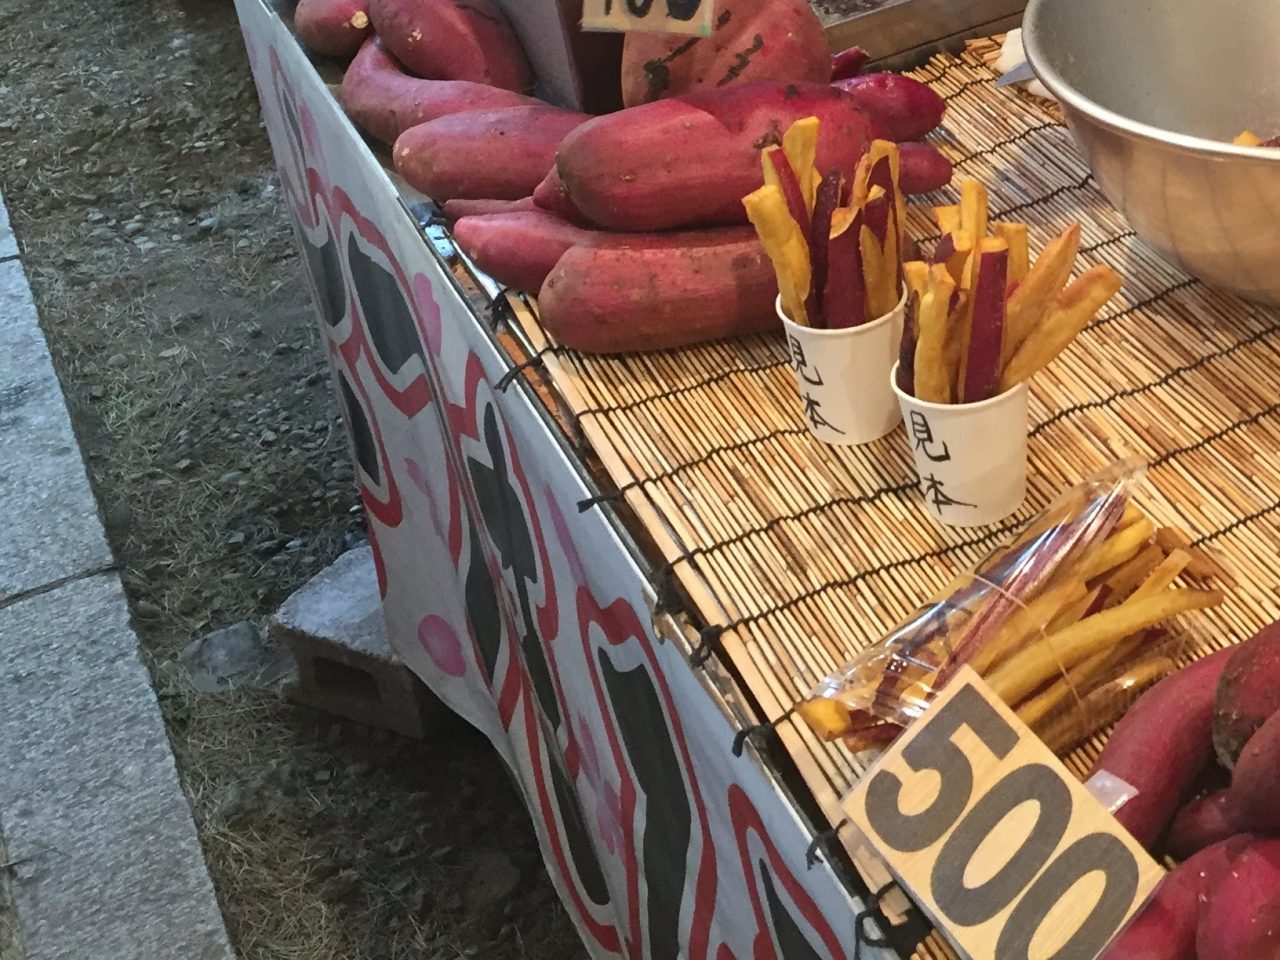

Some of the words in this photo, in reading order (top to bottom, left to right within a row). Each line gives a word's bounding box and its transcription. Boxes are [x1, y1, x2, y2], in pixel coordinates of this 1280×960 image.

[789, 333, 846, 434] 見本
[910, 410, 978, 515] 見本
[865, 682, 1140, 960] 500
